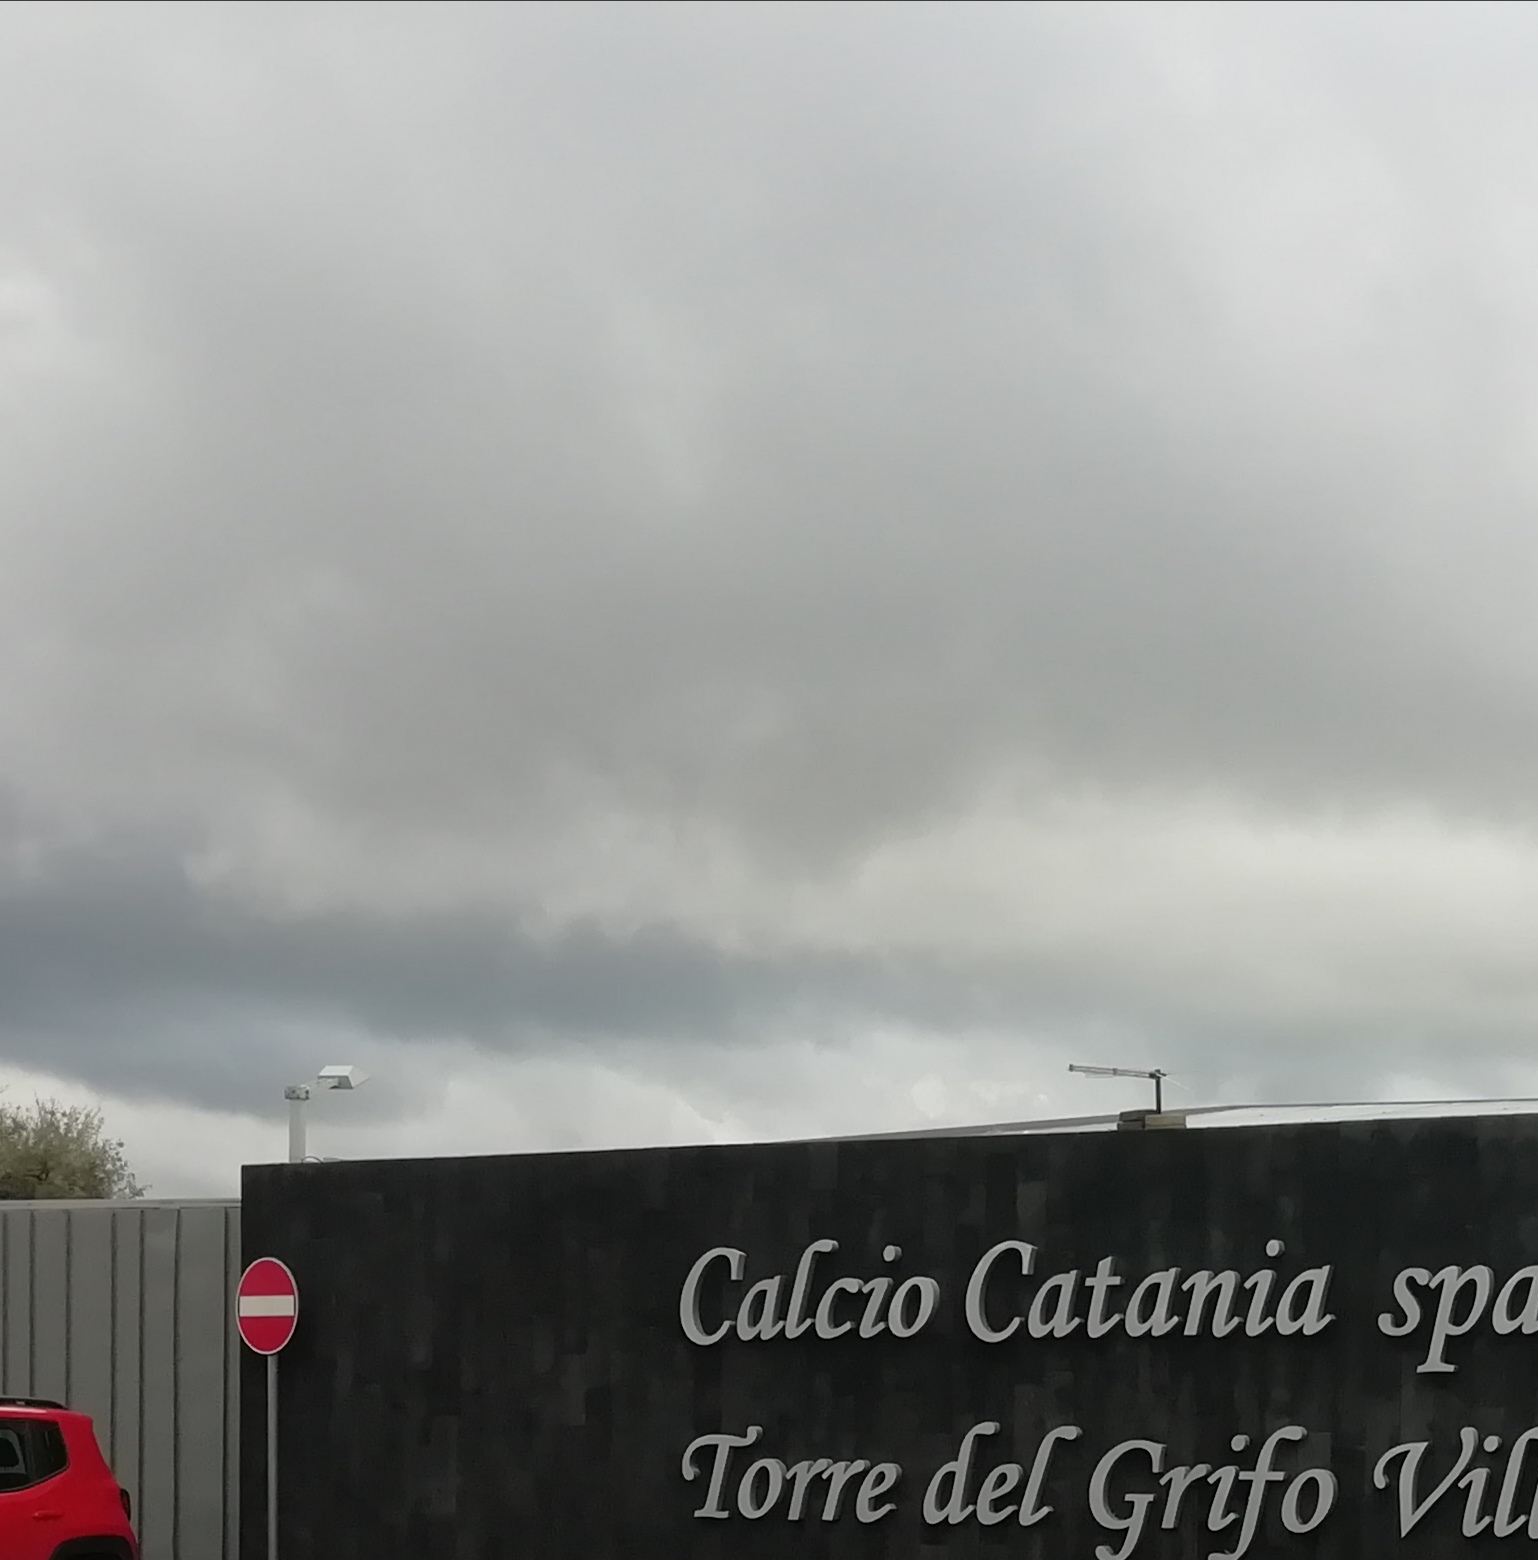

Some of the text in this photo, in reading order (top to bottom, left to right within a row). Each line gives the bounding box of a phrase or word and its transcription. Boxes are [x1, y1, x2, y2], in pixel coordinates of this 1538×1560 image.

[679, 1238, 941, 1346] Calcio
[964, 1237, 1334, 1344] Catania
[681, 1424, 900, 1525] Torre
[921, 1420, 1082, 1527] del
